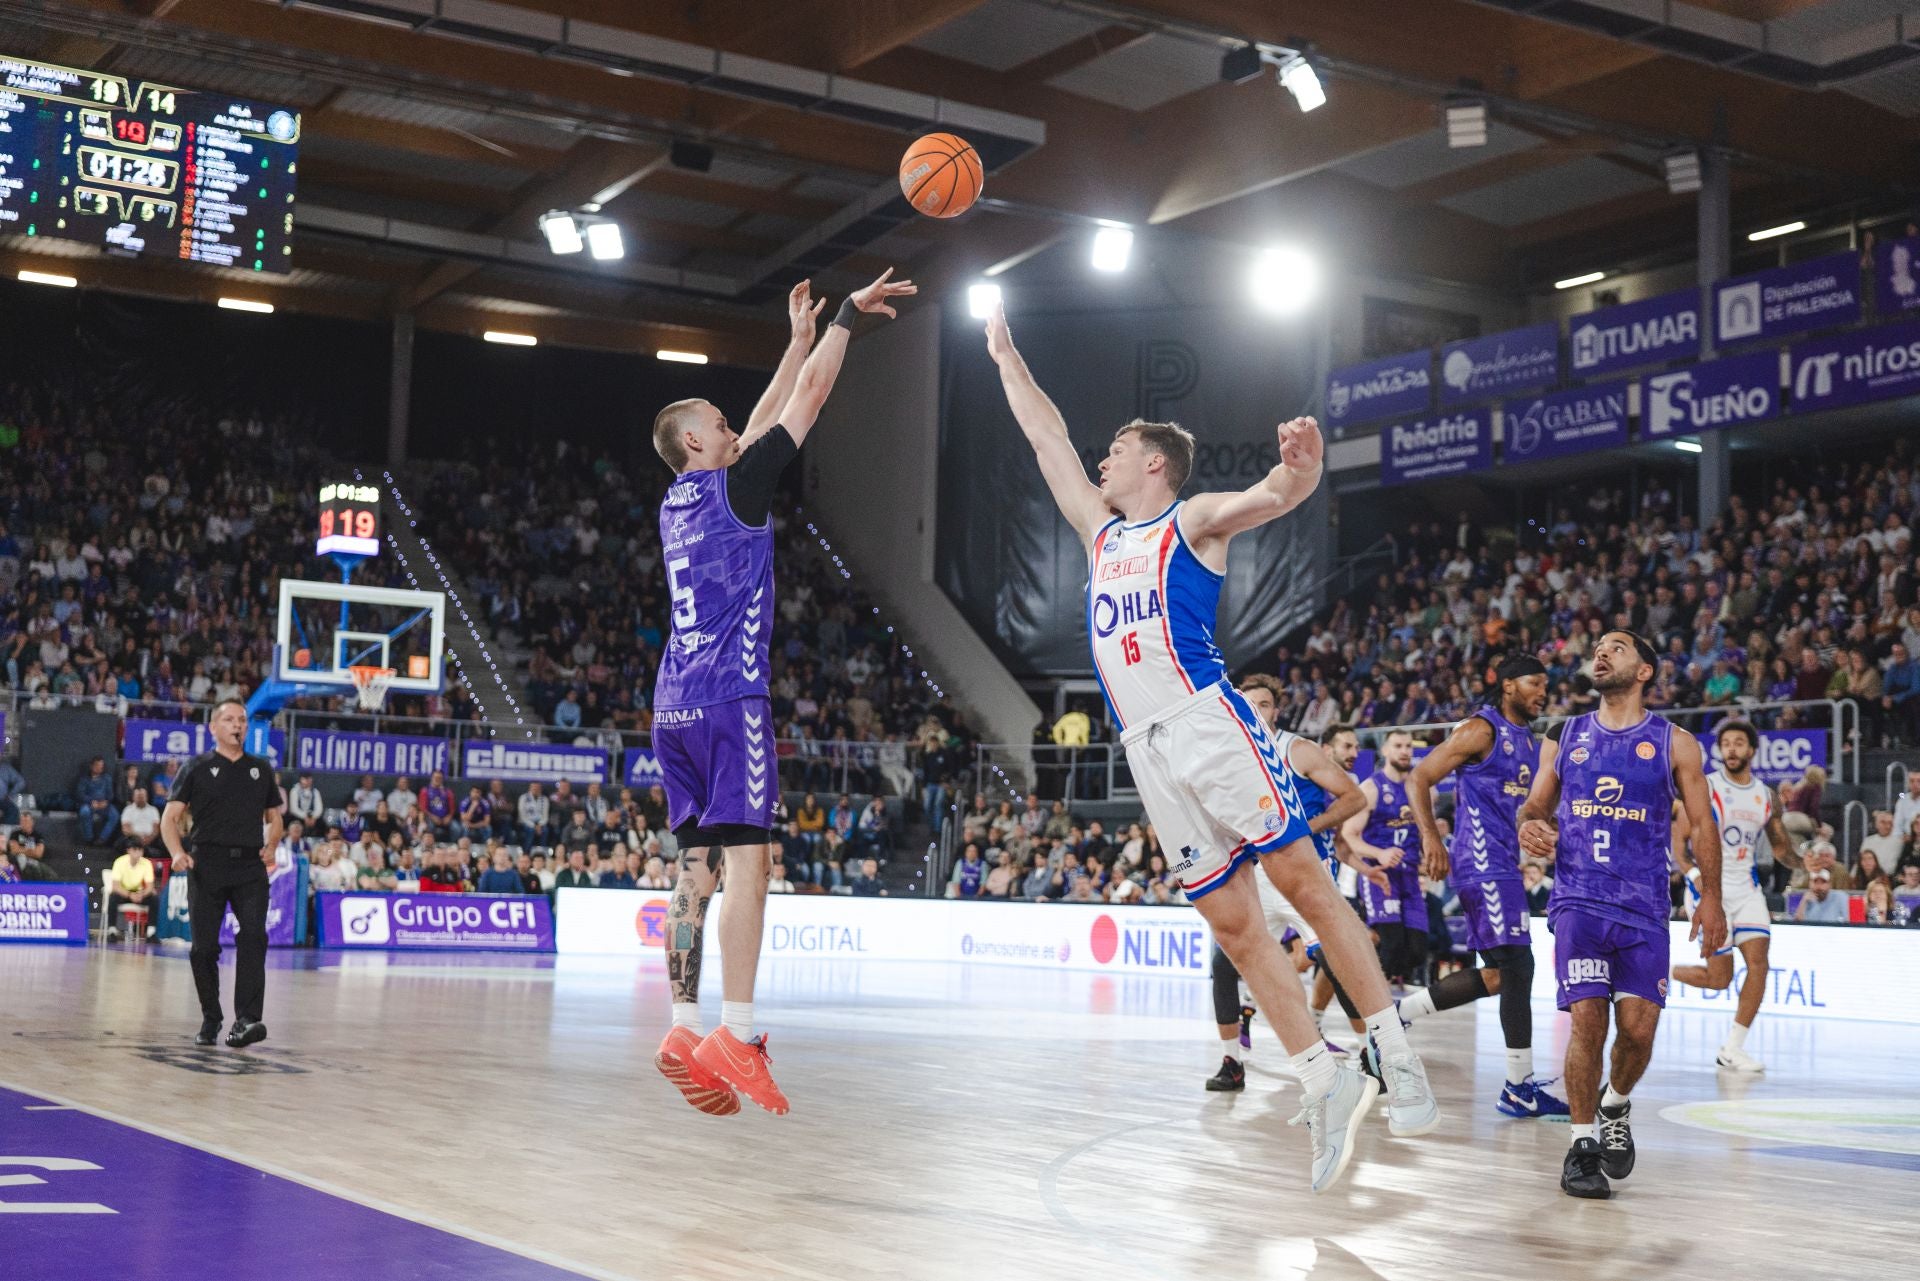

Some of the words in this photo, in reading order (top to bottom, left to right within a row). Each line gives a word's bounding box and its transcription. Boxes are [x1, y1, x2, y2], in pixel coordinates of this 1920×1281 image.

[148, 90, 176, 115] 14
[338, 508, 375, 539] 19
[669, 556, 697, 629] 5
[1122, 589, 1163, 625] HLA
[1121, 631, 1142, 666] 15
[301, 735, 387, 773] CLÍNICA
[466, 745, 604, 773] clomar
[1571, 803, 1647, 822] agropal
[1593, 829, 1611, 863] 2
[392, 898, 482, 932] Grupo
[488, 901, 537, 929] CFI
[772, 924, 869, 953] DIGITAL
